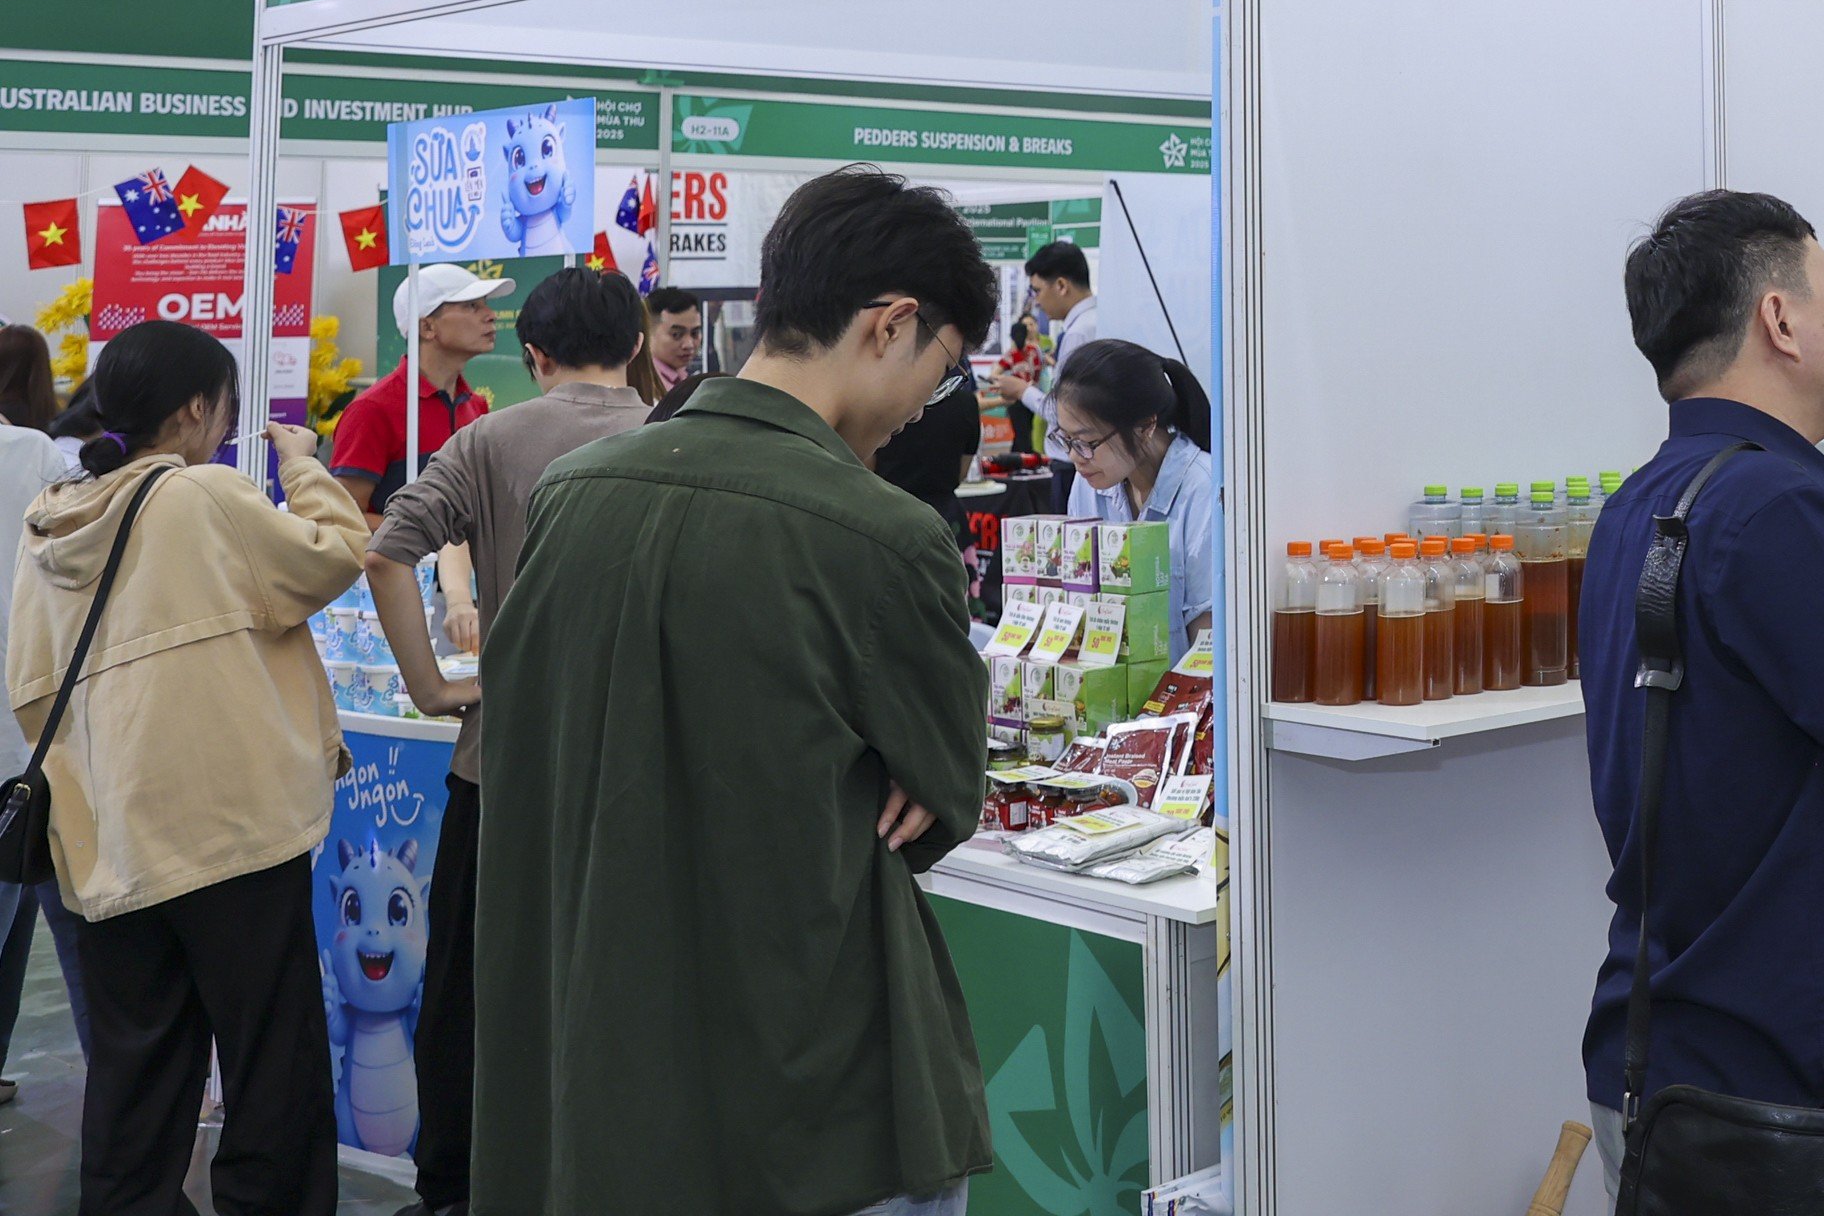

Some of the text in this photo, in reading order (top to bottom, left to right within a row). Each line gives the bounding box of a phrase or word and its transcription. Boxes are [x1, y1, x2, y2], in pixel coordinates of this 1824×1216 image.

[139, 92, 247, 118] BUSINESS
[304, 98, 428, 123] INVESTMENT
[623, 116, 645, 127] THU
[597, 129, 624, 140] 2025
[691, 125, 730, 137] H2-11A
[854, 127, 1073, 156] PEDDERS SUSPENSION & BREAKS
[157, 292, 245, 321] OEM
[361, 779, 409, 828] ngon
